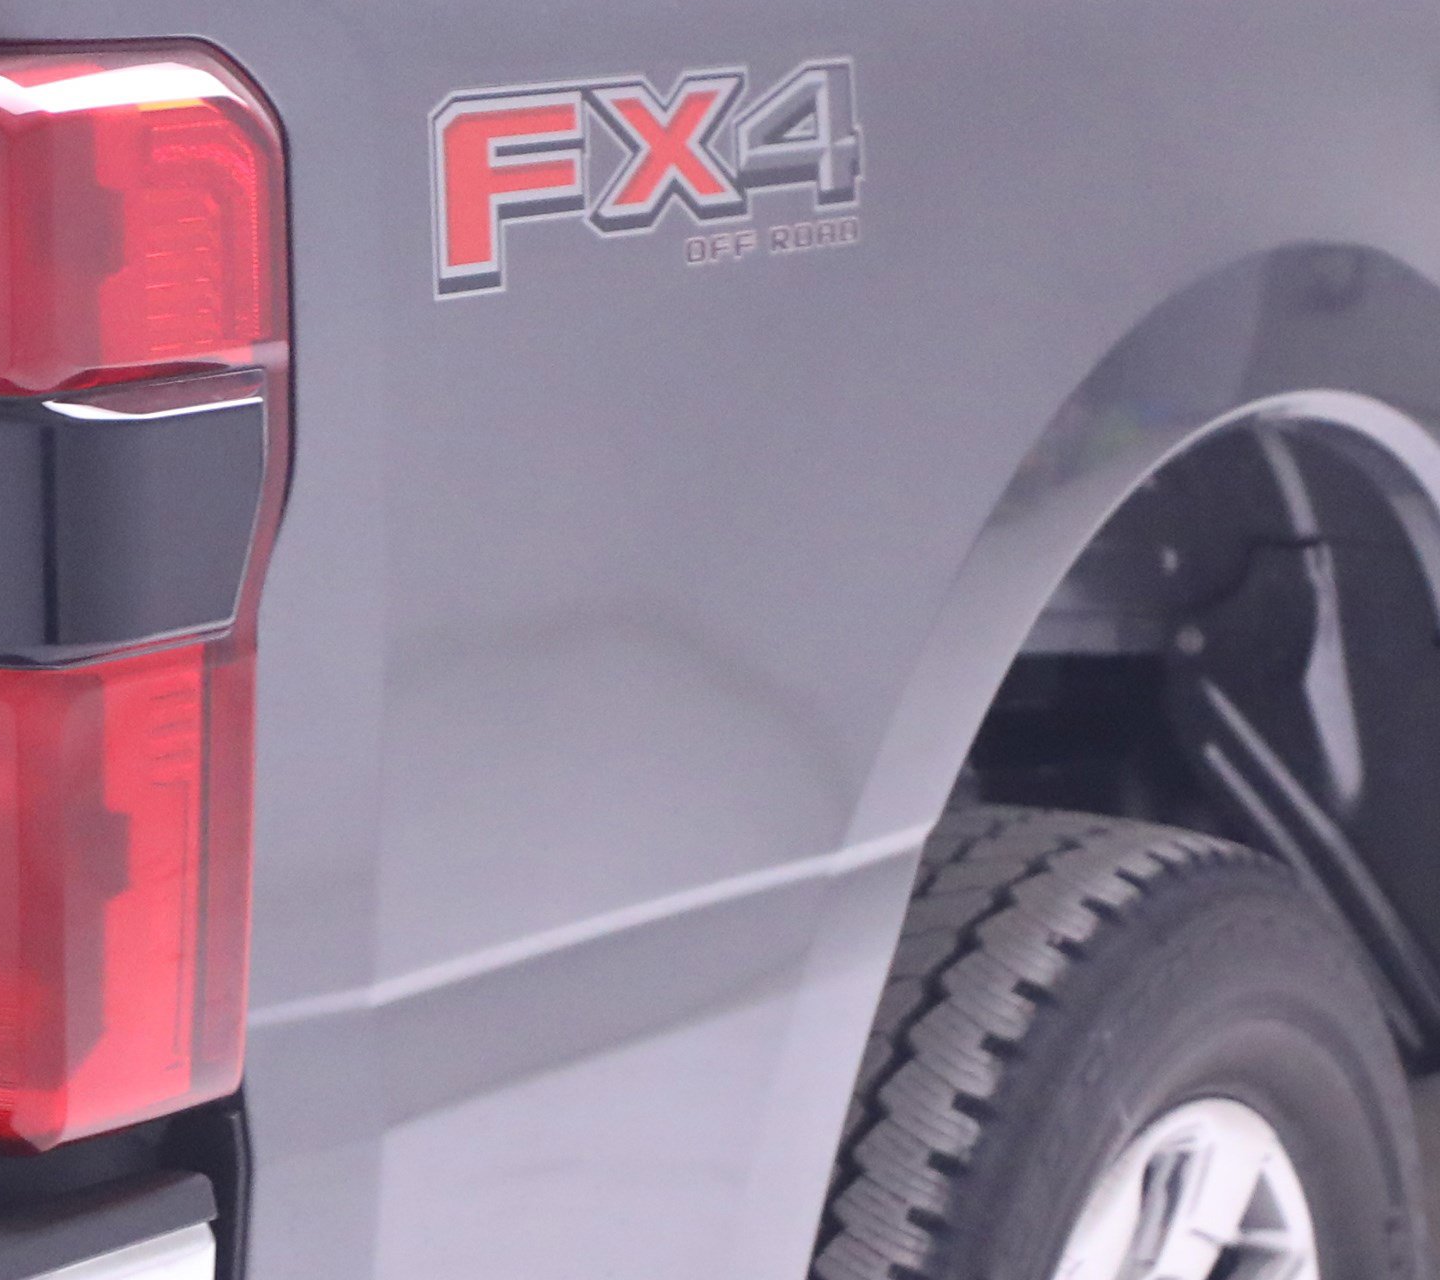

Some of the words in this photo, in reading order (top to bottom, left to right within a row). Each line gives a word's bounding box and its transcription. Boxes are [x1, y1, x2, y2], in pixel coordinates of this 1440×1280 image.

[428, 56, 864, 301] FX4
[685, 229, 756, 265] OFF
[769, 216, 859, 254] ROAD
